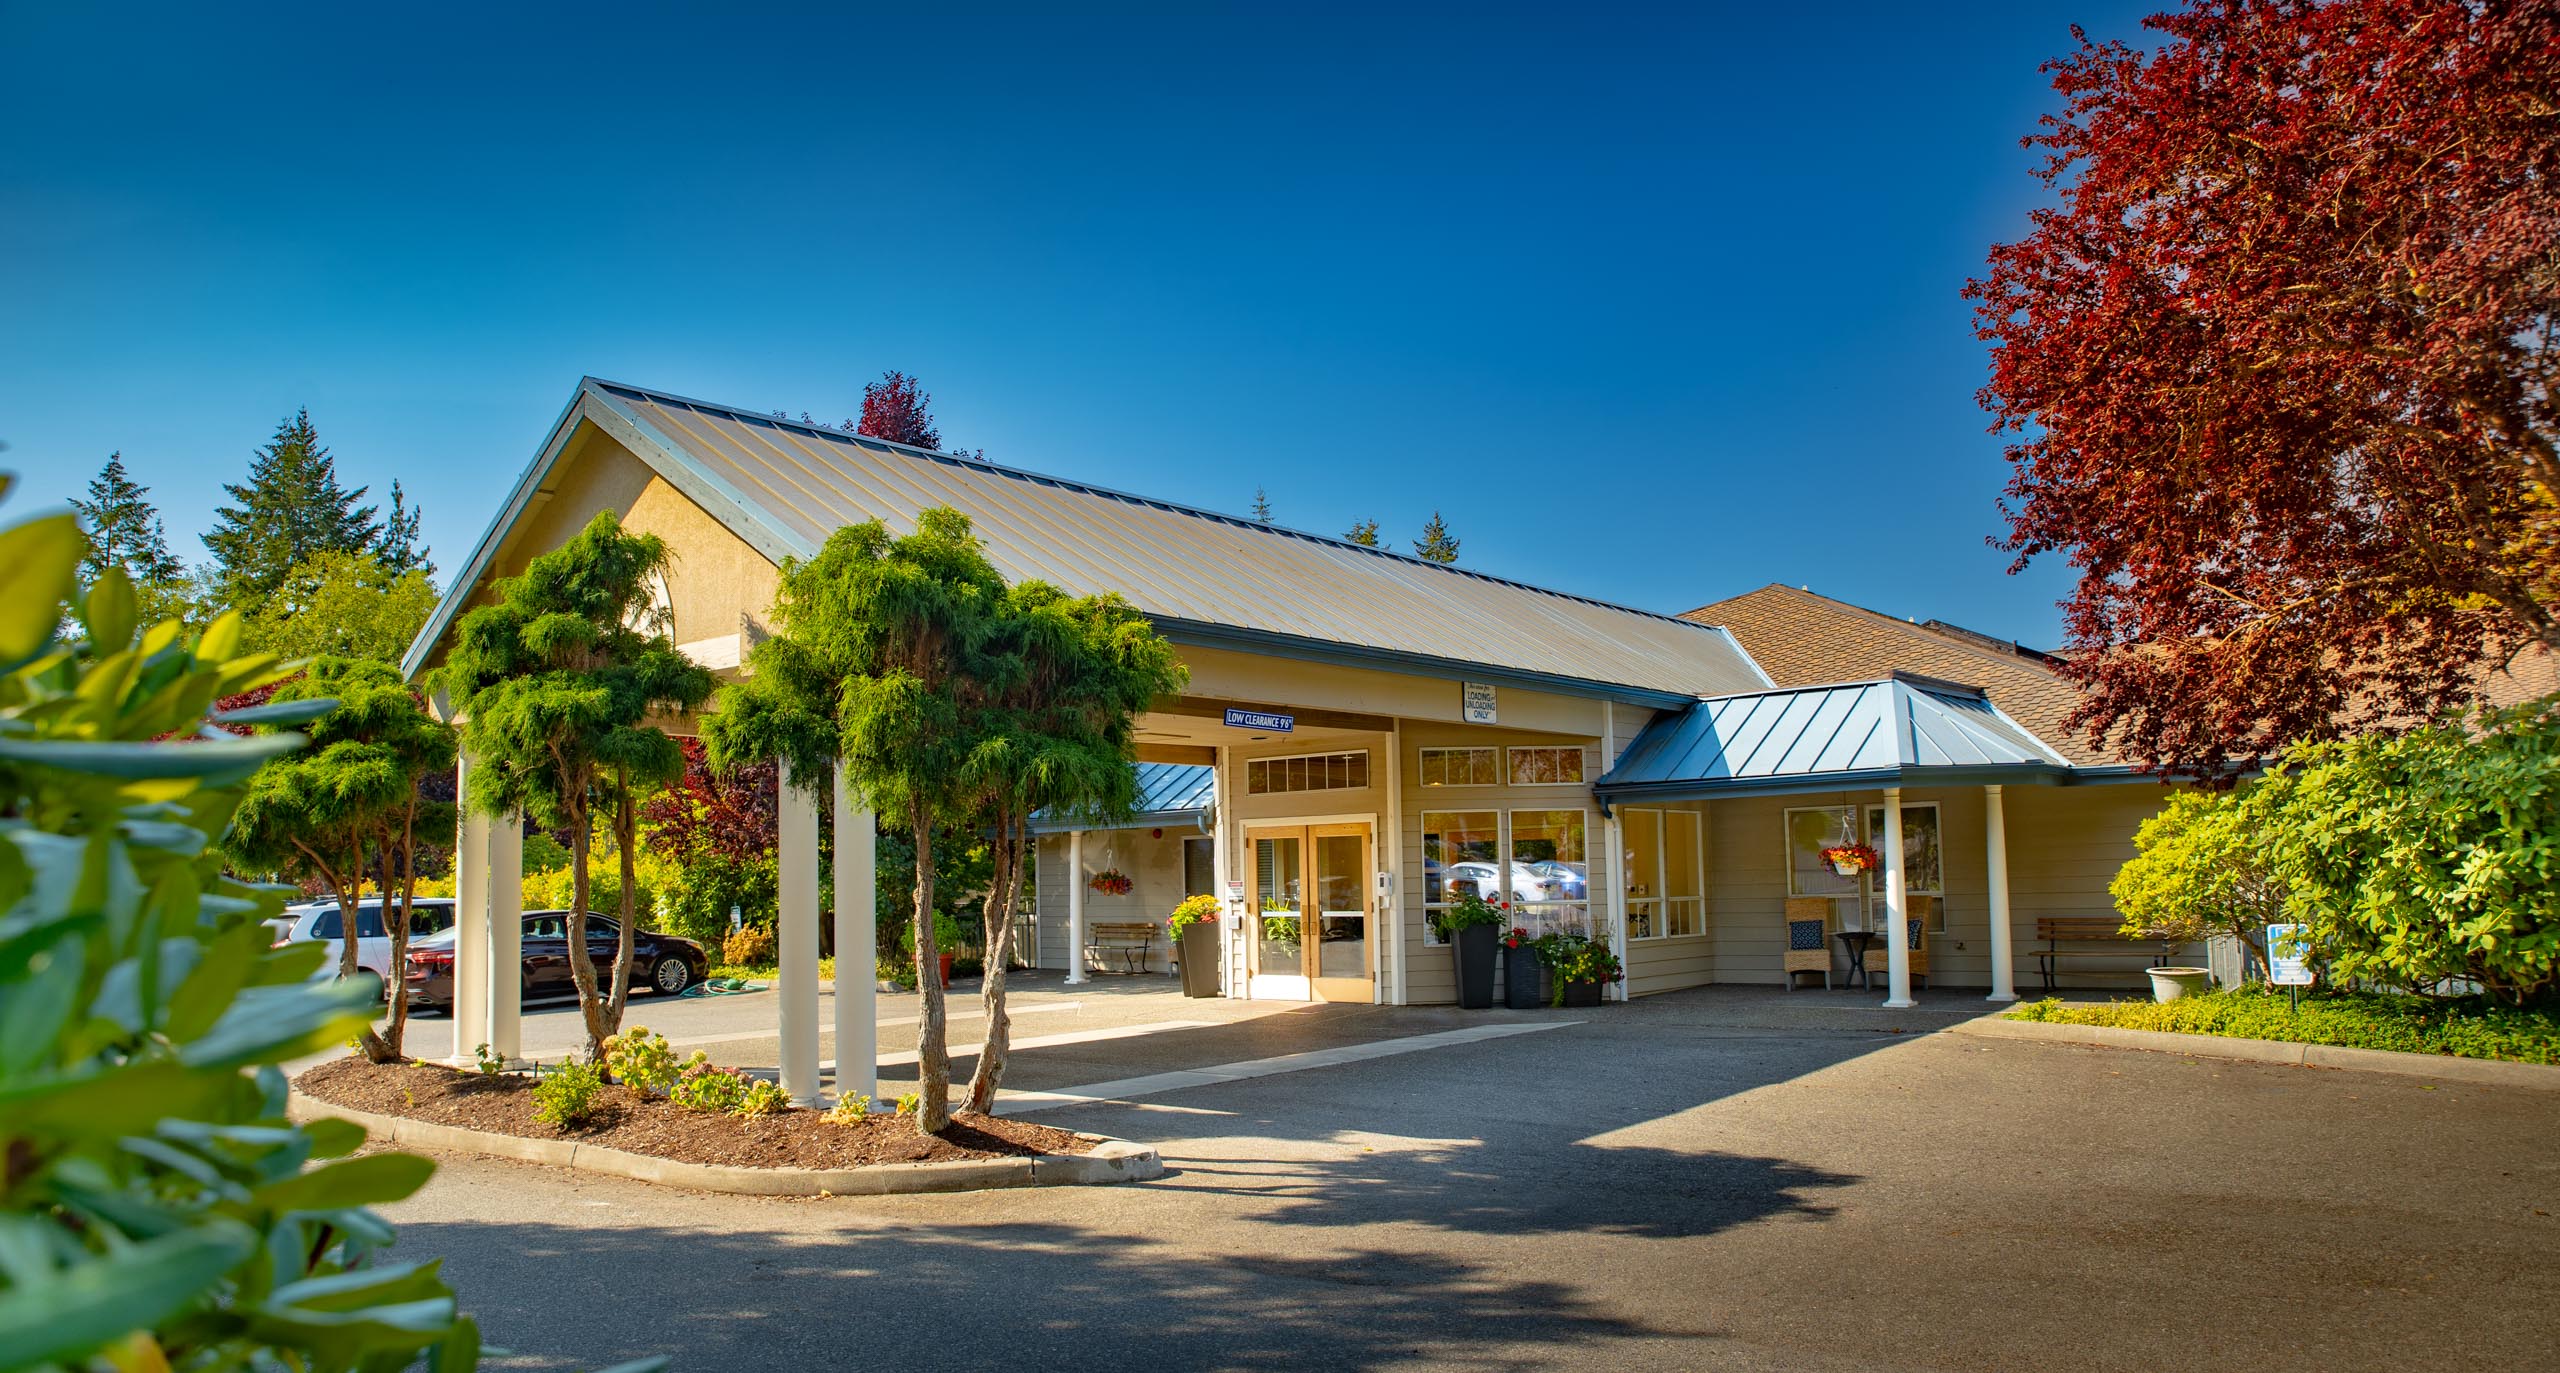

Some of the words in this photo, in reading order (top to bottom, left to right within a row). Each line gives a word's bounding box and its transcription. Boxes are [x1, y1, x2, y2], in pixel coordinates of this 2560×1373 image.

[1467, 691, 1491, 701] LOADING
[1466, 700, 1496, 711] UNLOADING
[1474, 710, 1489, 719] ONLY
[1228, 712, 1245, 724] LOW
[1245, 714, 1279, 728] CLEARANCE
